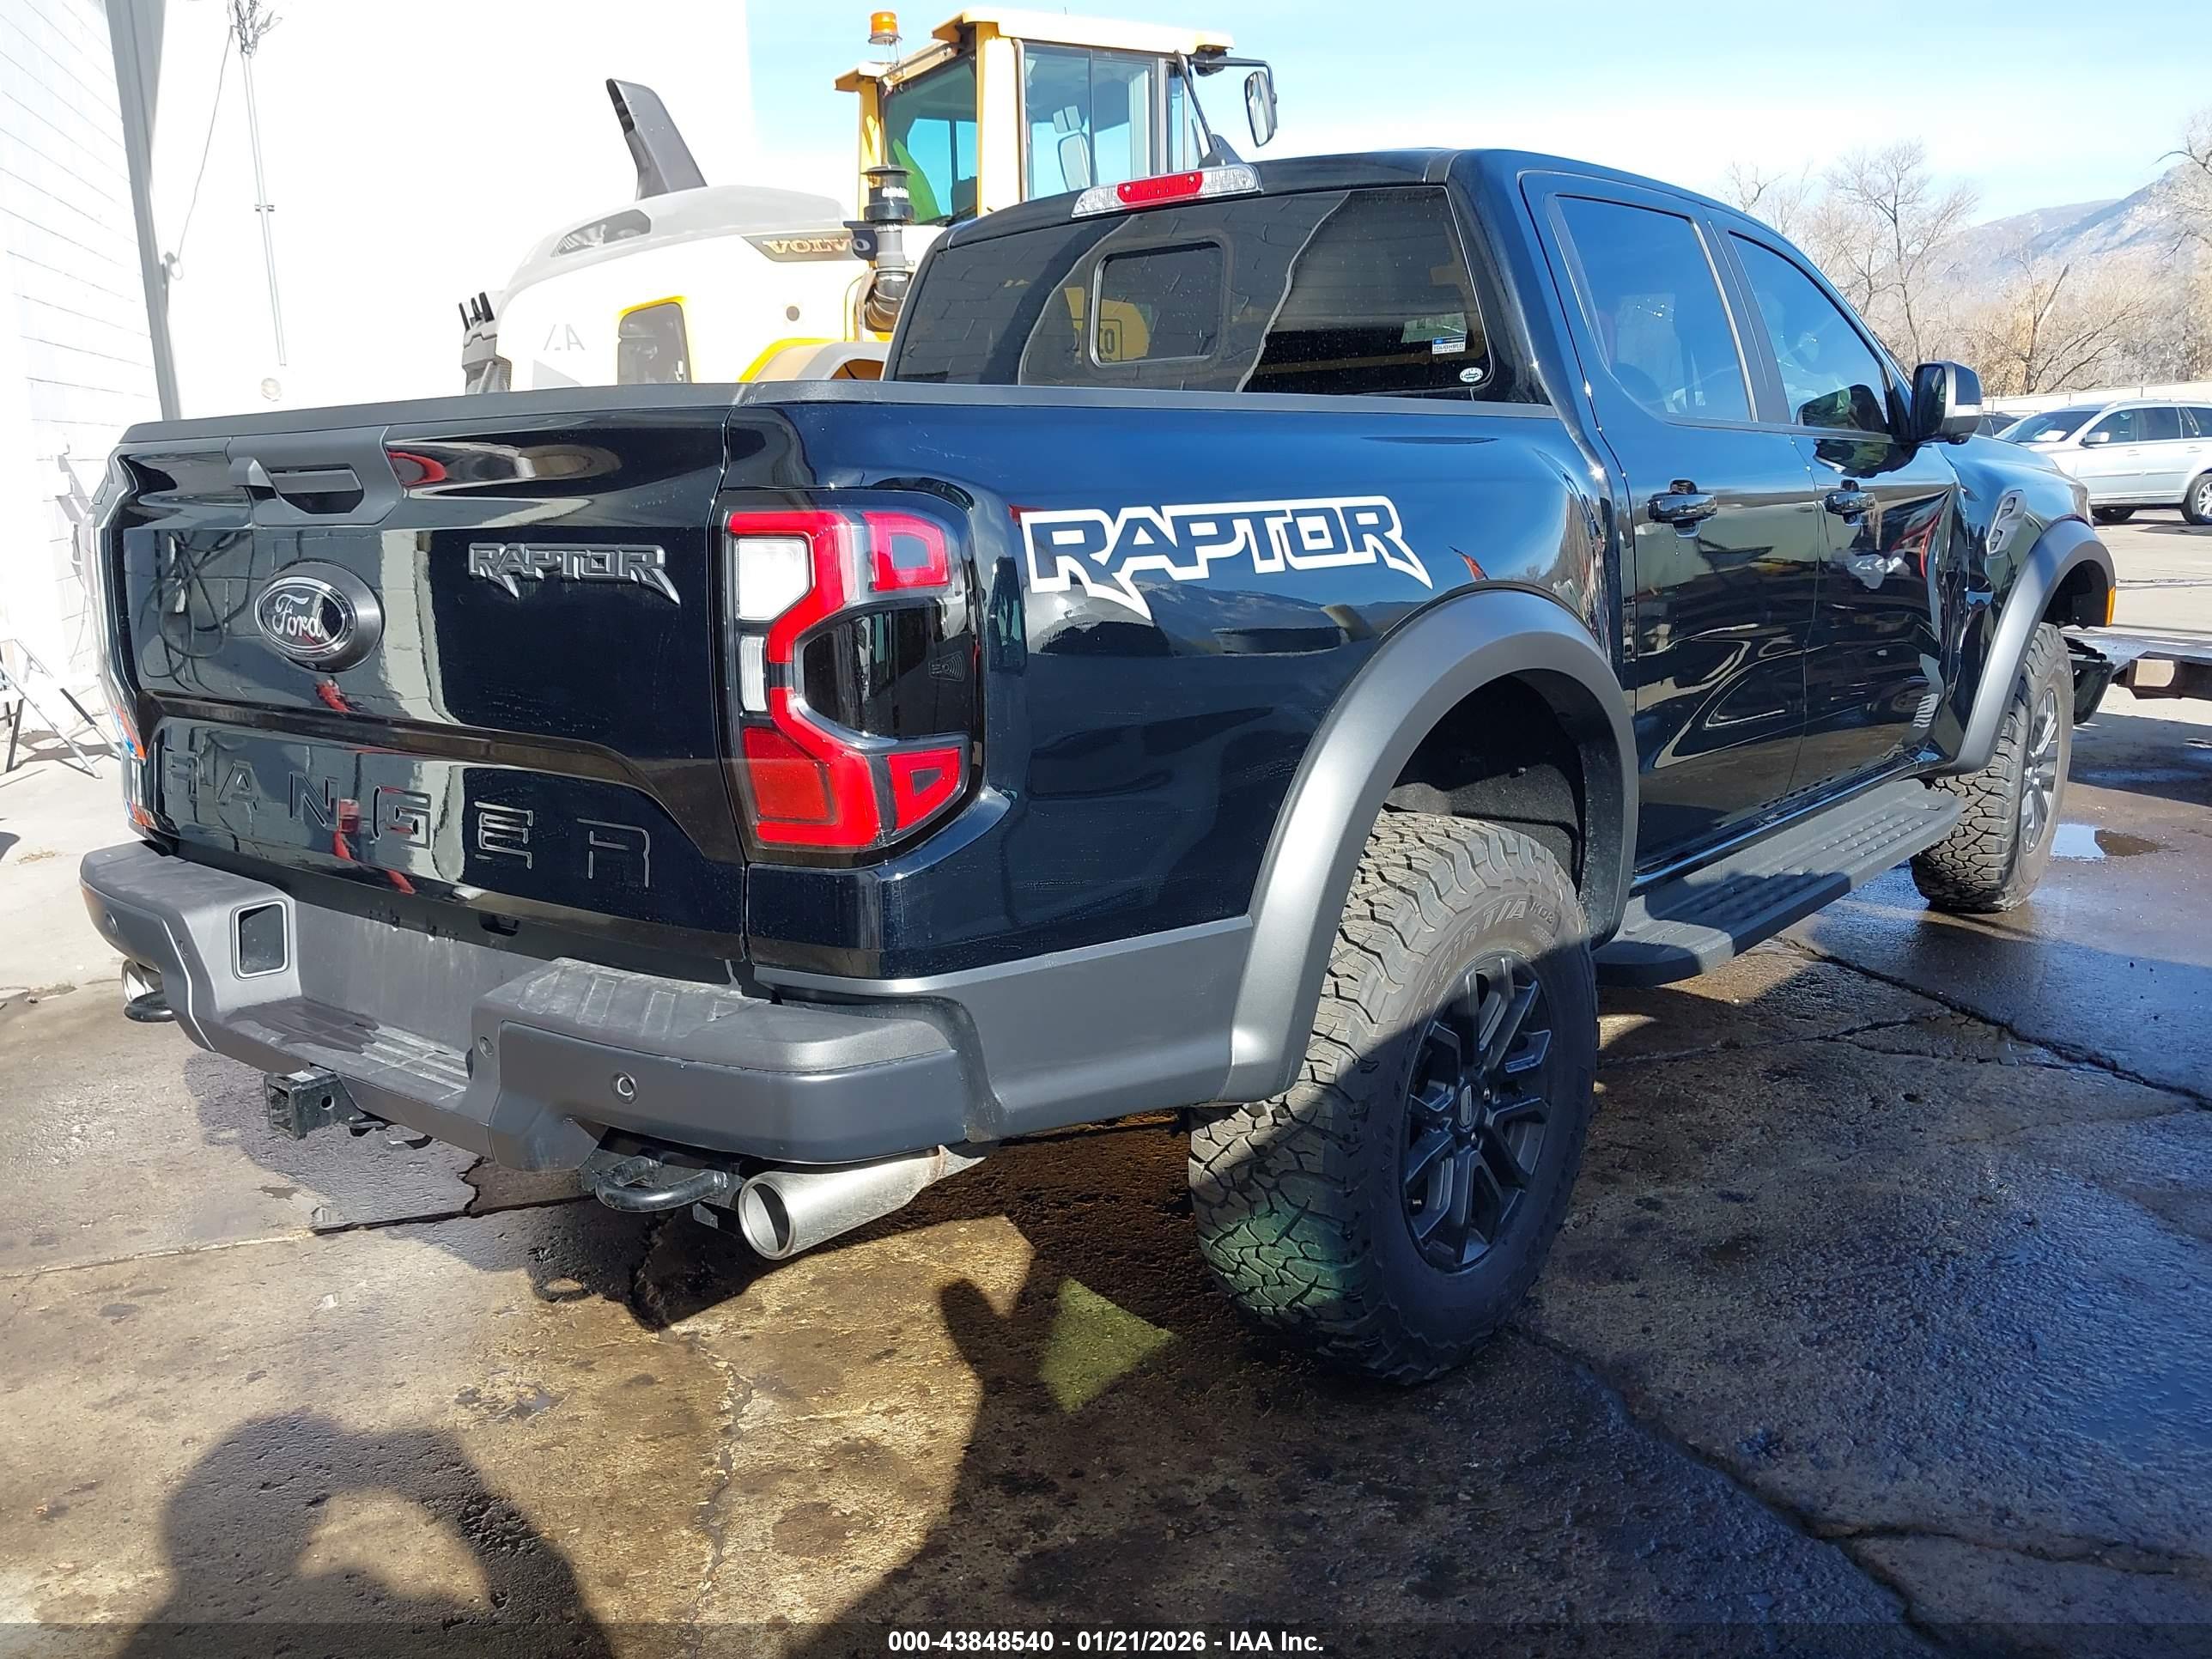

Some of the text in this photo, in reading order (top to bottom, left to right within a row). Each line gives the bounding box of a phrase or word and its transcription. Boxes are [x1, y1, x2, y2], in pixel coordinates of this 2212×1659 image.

[762, 237, 872, 254] VOLVO
[468, 542, 681, 605] RAPTOR
[1019, 495, 1434, 621] RAPTOR
[271, 592, 325, 638] Ford
[163, 744, 651, 888] RANGER
